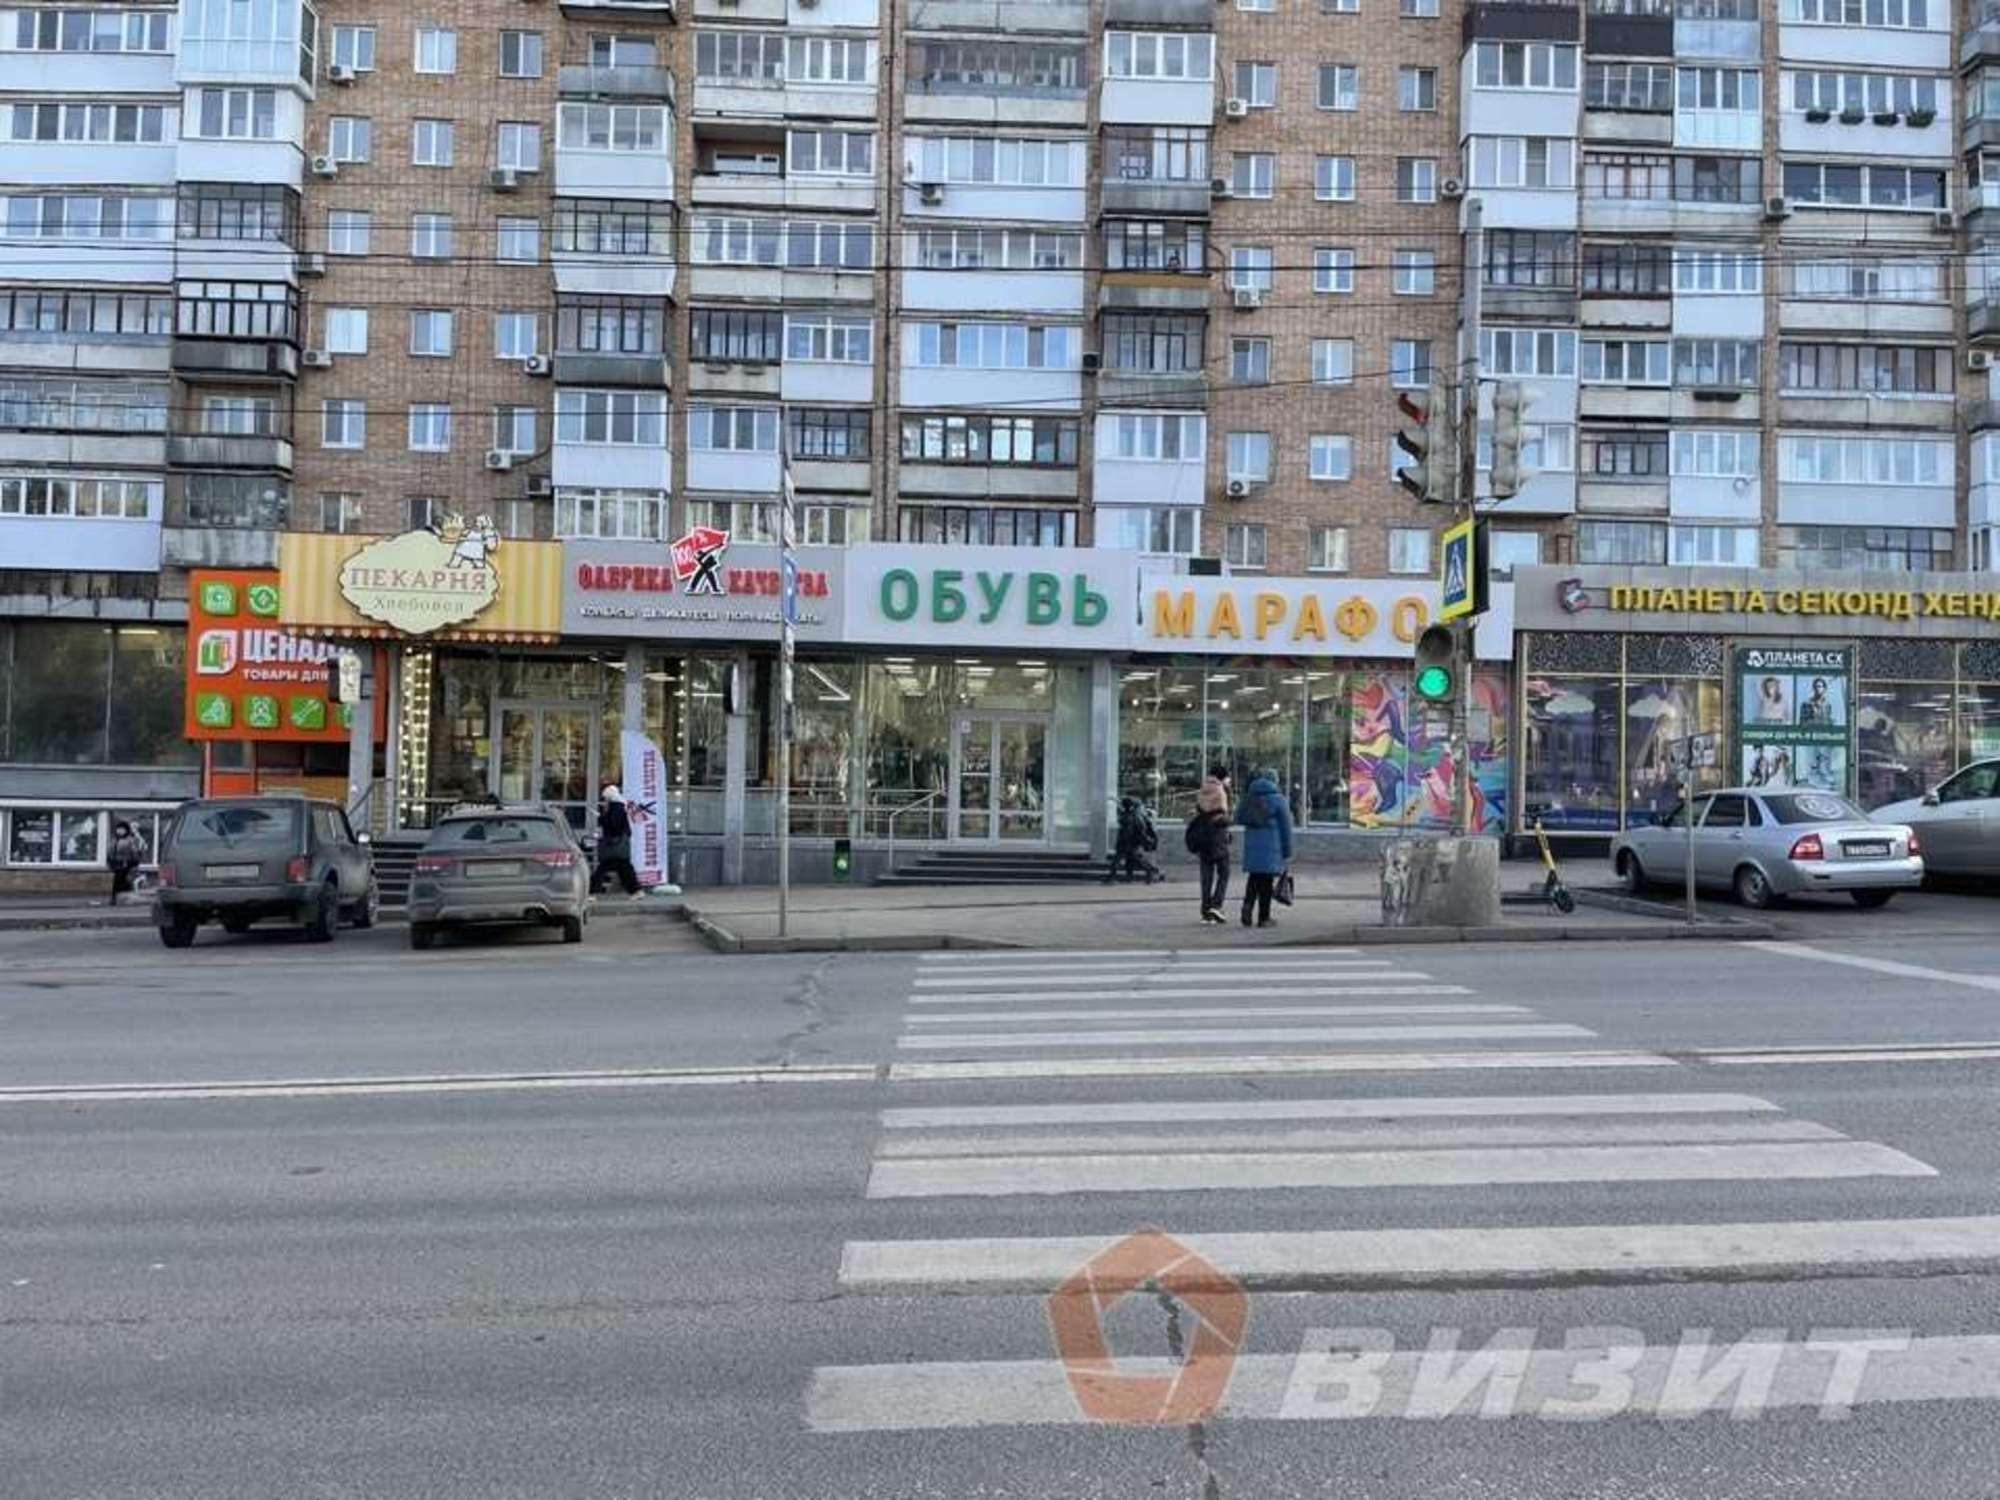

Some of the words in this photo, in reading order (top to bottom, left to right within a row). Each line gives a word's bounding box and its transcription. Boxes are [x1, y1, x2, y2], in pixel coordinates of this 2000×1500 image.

[350, 568, 486, 590] ПЕКАРНЯ
[578, 563, 673, 592] ФАБРИКА
[880, 568, 1108, 626] ОБУВЬ
[1611, 585, 1767, 613] ПЛАНЕТА
[1776, 589, 1912, 620] СЕКОНД
[1764, 651, 1824, 664] ПЛАНЕТА
[243, 669, 298, 680] ТОВАРЫ
